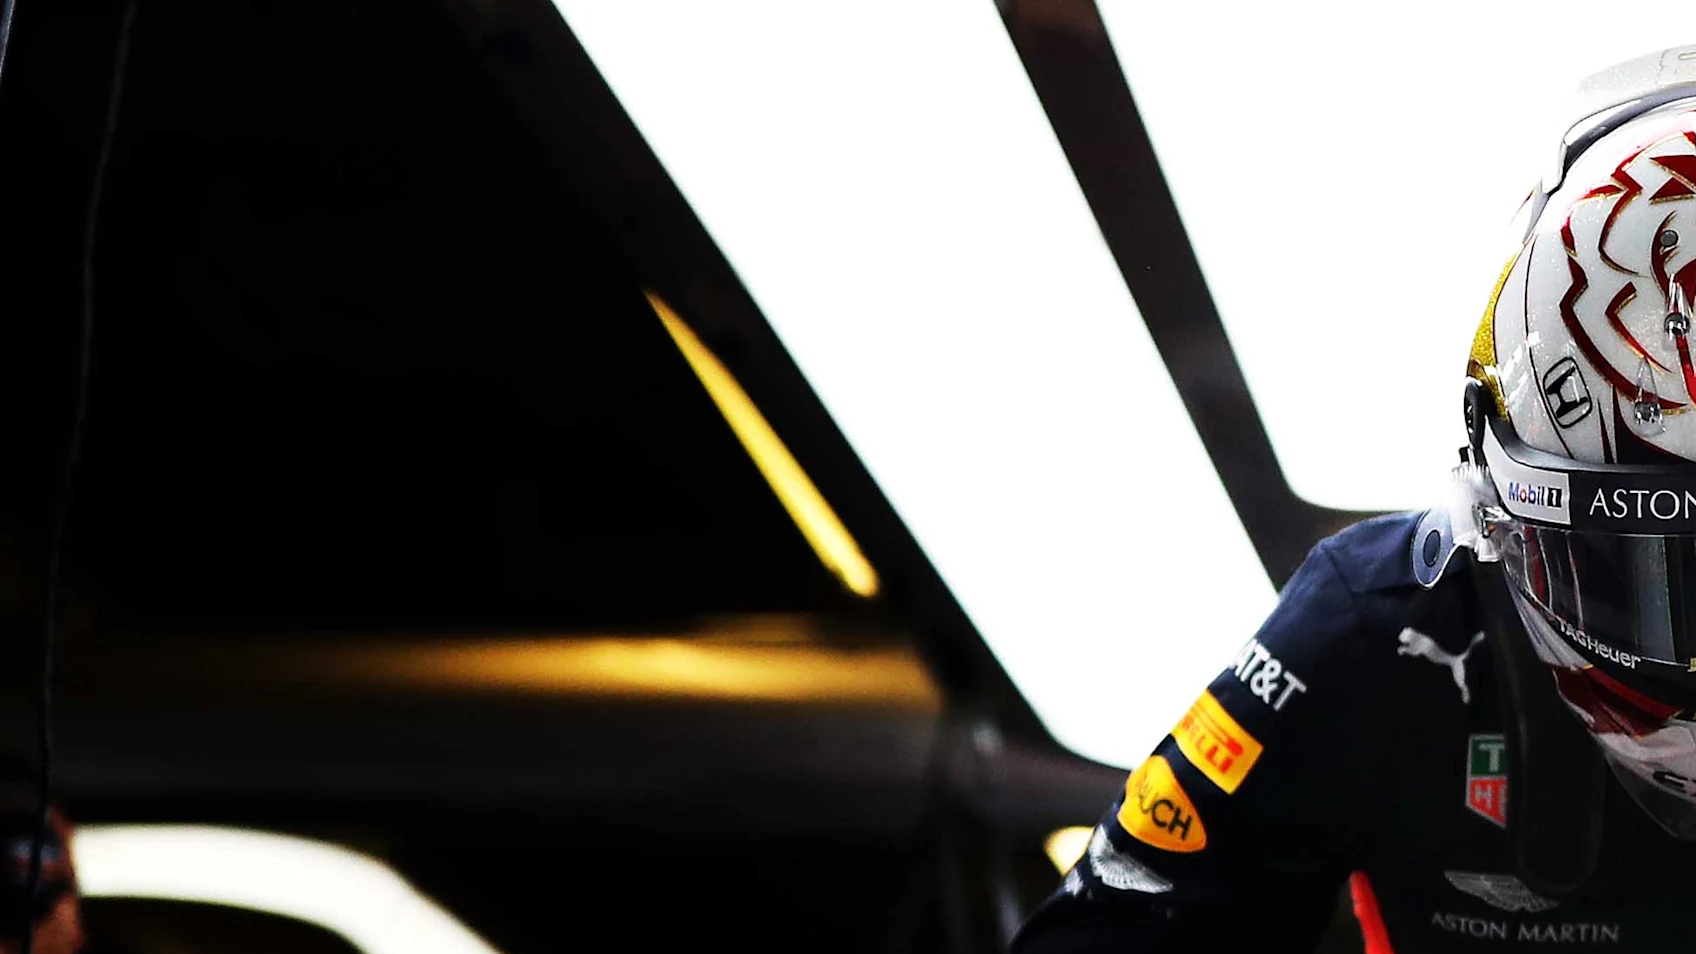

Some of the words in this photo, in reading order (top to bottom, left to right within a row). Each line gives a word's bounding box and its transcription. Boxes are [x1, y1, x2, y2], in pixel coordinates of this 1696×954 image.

[1508, 482, 1545, 507] Mobil
[1431, 911, 1507, 940] ASTON
[1517, 922, 1620, 945] MARTIN
